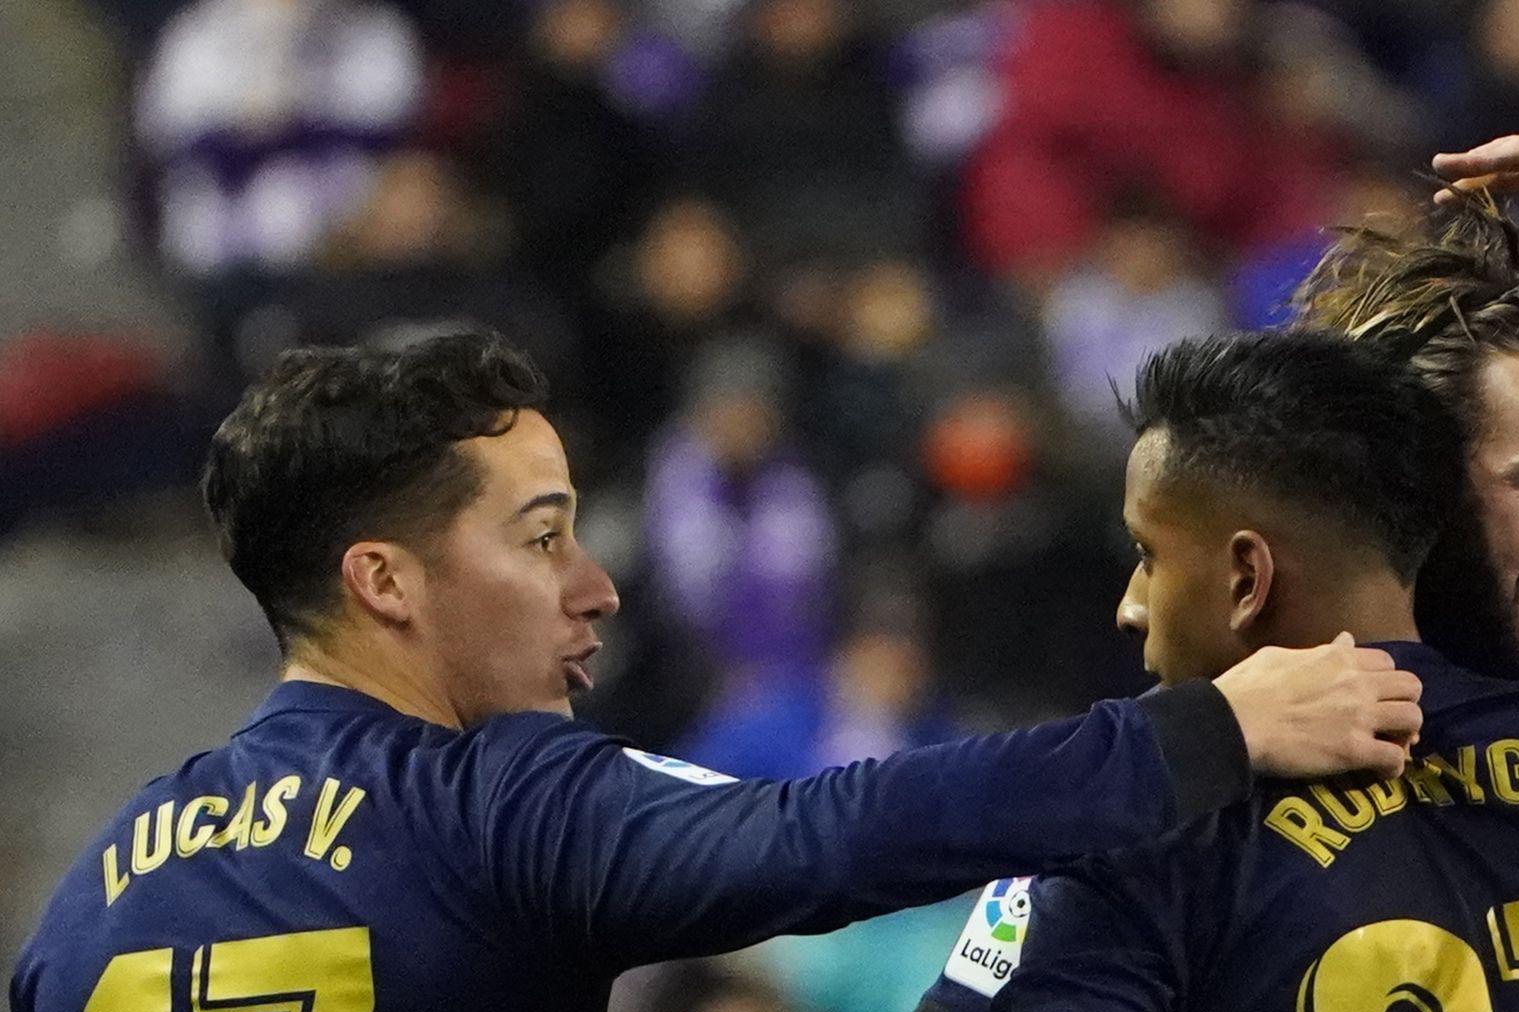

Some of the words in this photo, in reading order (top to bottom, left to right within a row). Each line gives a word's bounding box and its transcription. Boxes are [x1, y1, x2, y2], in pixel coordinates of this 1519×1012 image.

[102, 774, 300, 907] LUCAS
[303, 777, 366, 871] V.
[960, 938, 1018, 981] LaLig
